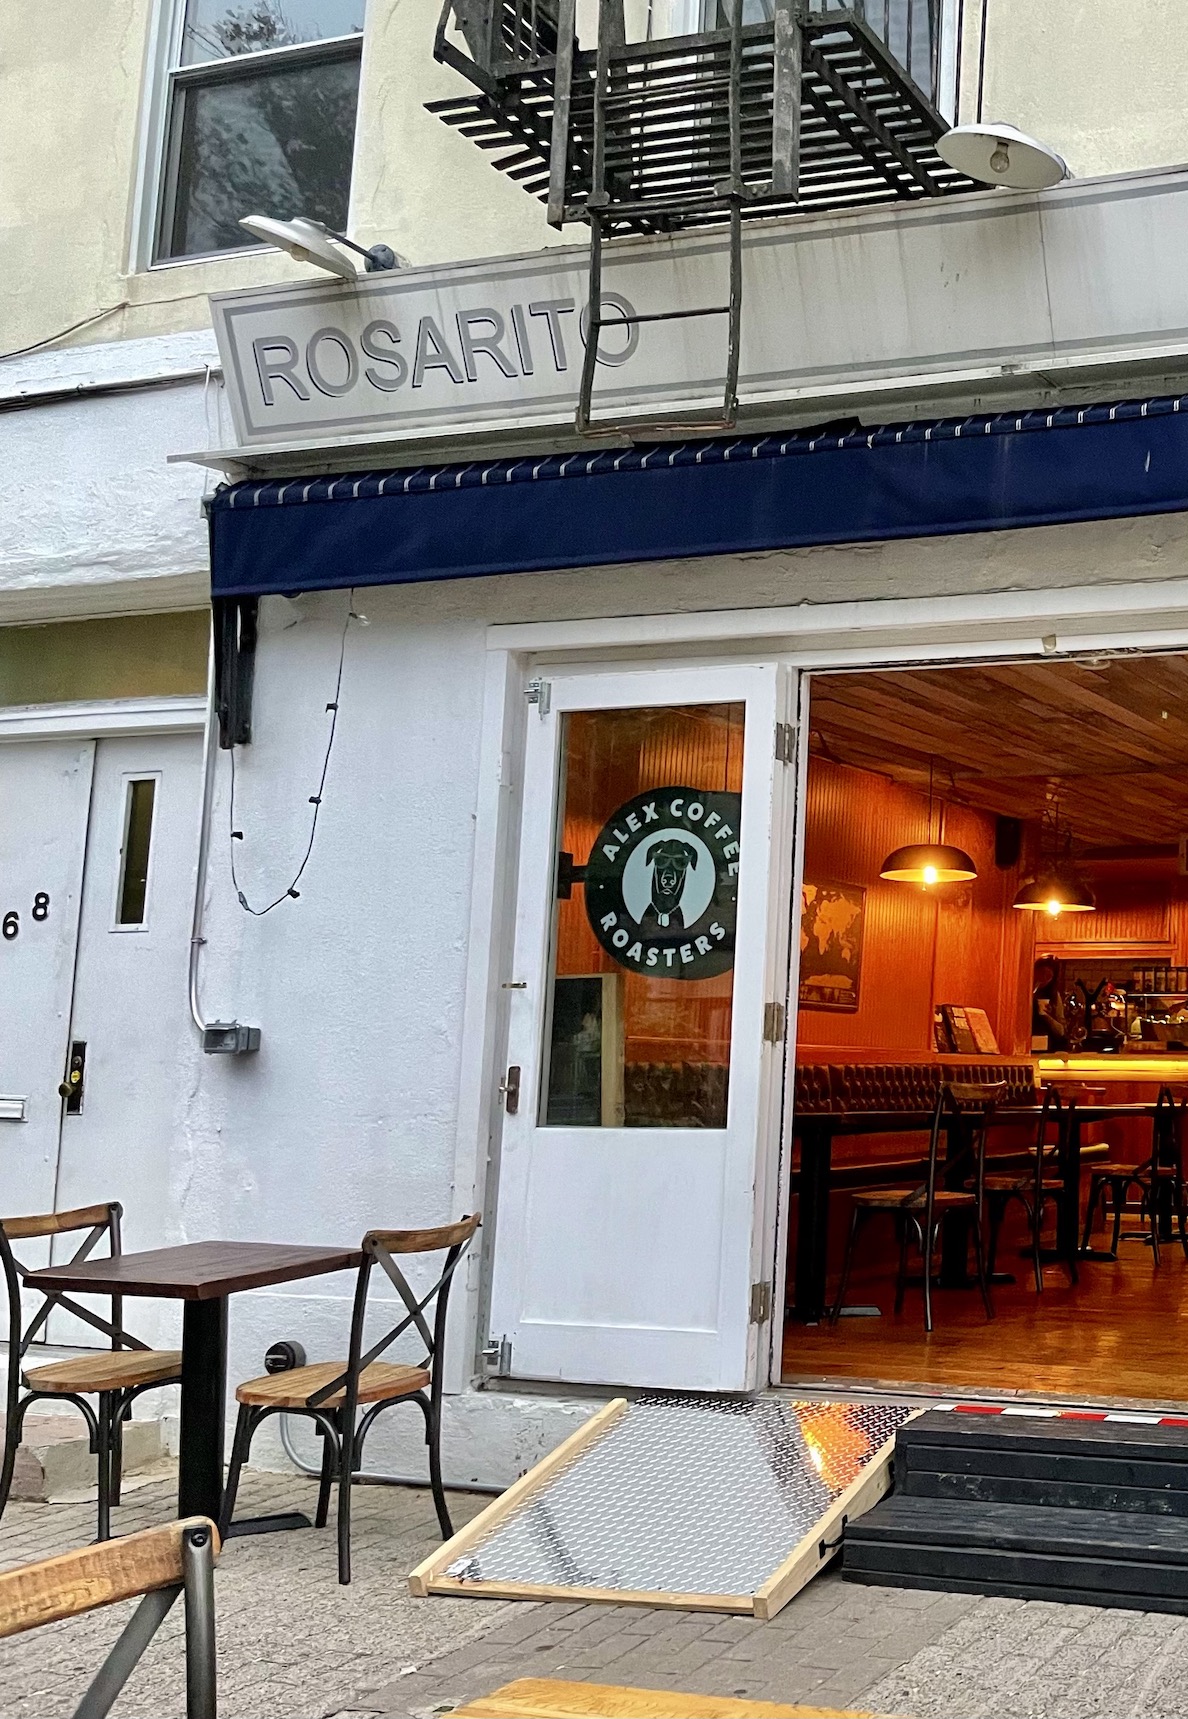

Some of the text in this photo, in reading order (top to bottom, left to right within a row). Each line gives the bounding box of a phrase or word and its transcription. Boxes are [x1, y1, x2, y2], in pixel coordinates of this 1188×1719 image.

[252, 290, 640, 407] ROSARITO
[602, 798, 740, 877] ALEX COFFEE
[600, 911, 726, 967] ROASTERS
